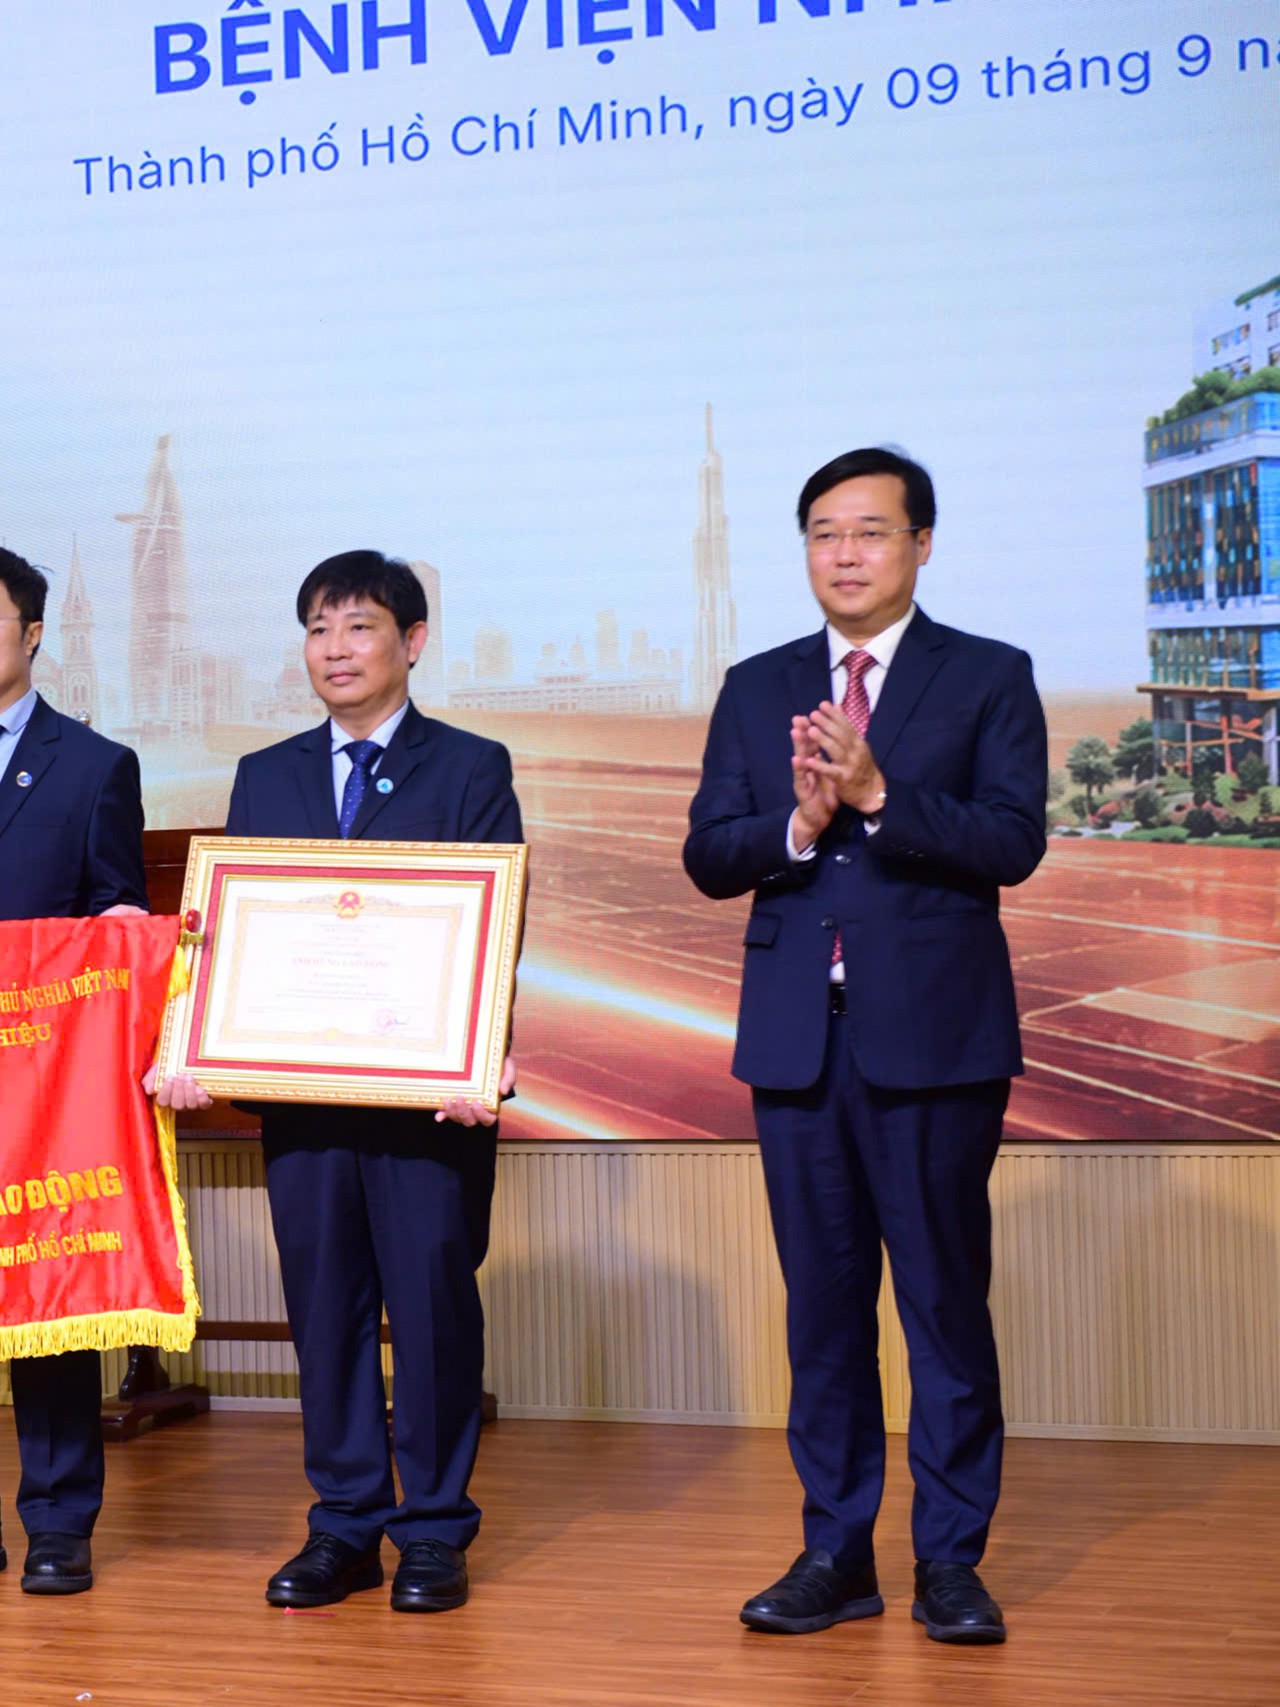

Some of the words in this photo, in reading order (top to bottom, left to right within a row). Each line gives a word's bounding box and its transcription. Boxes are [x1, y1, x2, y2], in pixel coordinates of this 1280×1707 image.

[154, 0, 428, 106] BỆNH
[73, 145, 225, 196] Thành
[247, 121, 340, 189] phố
[361, 112, 430, 167] Hồ
[451, 107, 538, 156] Chí
[558, 95, 704, 146] Minh,
[729, 76, 865, 134] ngày
[886, 62, 960, 110] 09
[980, 47, 1152, 100] tháng
[1175, 33, 1212, 79] 9
[1237, 36, 1280, 73] n
[72, 966, 103, 999] VIỆT
[24, 1165, 124, 1213] ĐỘNG
[38, 1230, 61, 1260] HỒ
[61, 1228, 87, 1256] CHÍ
[87, 1231, 124, 1253] MINH
